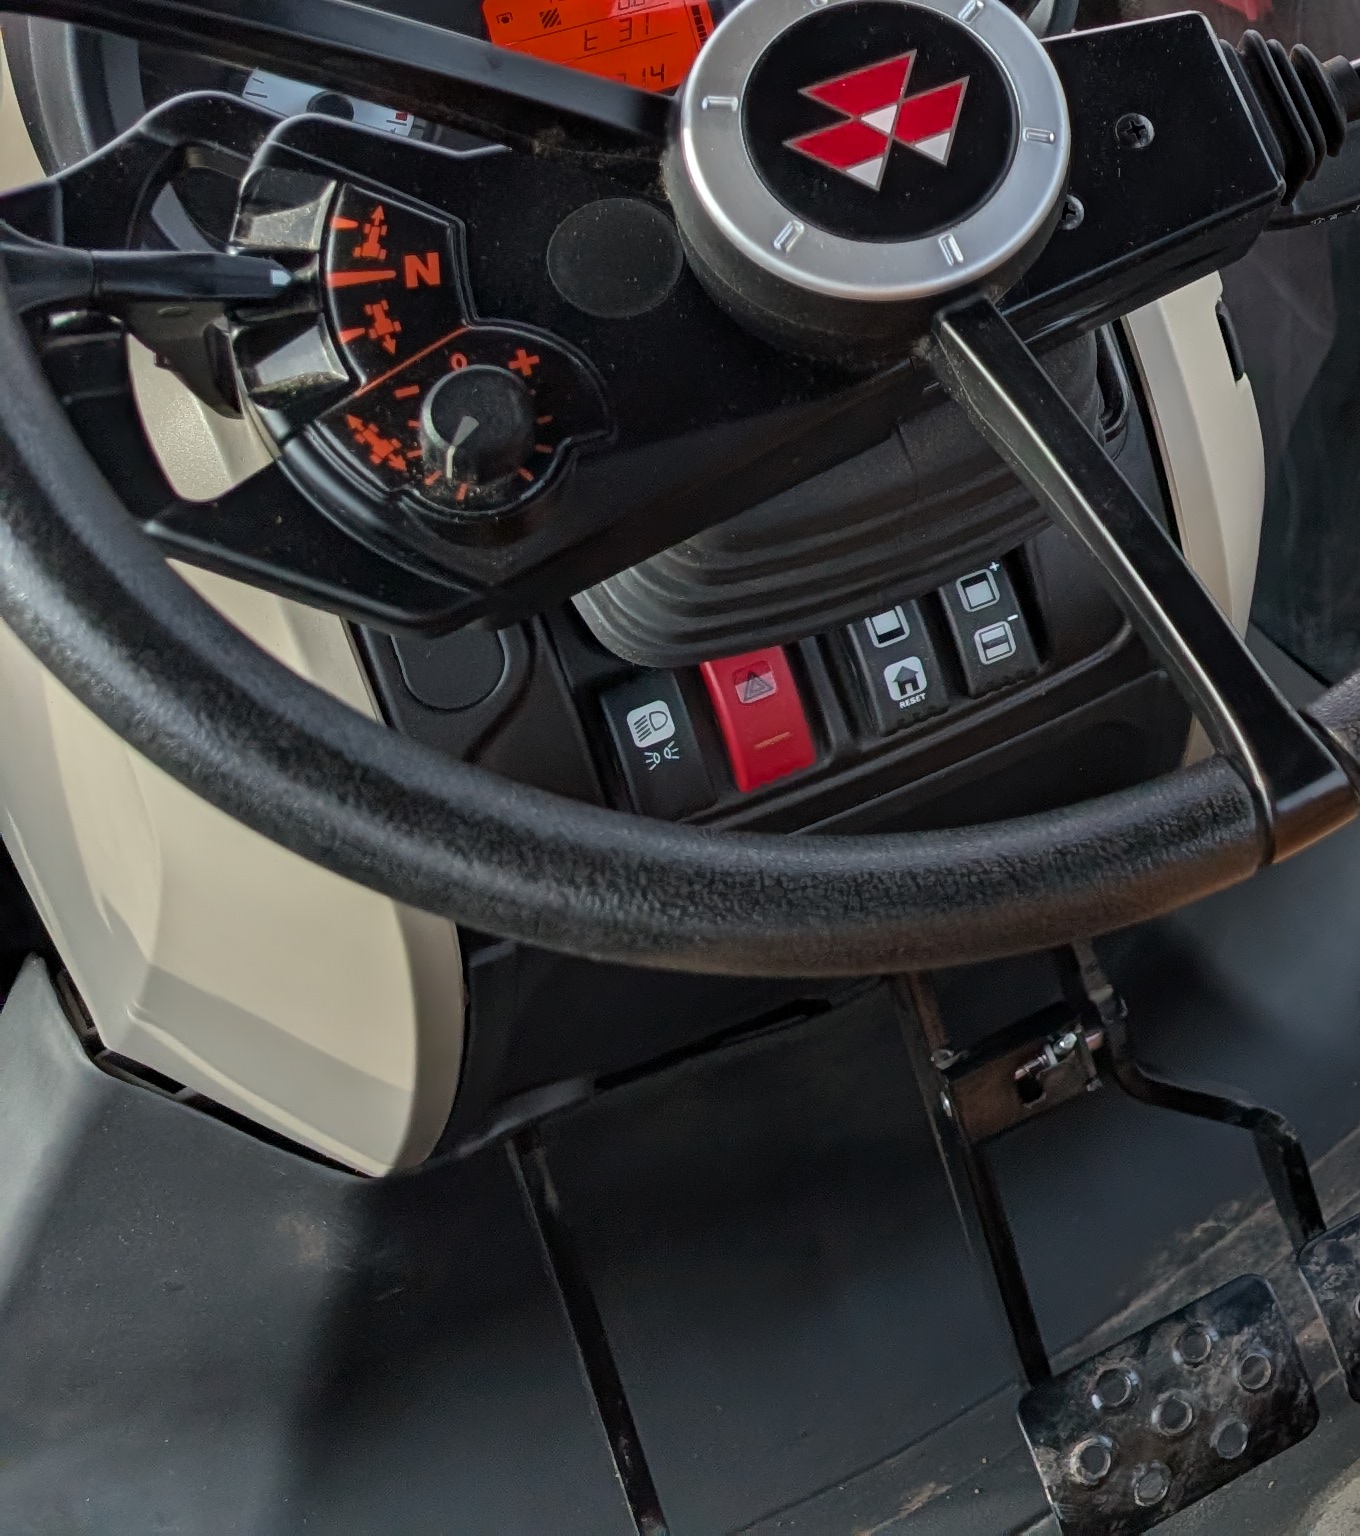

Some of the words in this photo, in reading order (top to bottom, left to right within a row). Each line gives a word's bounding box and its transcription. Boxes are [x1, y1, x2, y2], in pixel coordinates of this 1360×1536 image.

[618, 14, 650, 43] 31
[404, 251, 441, 288] N
[451, 352, 468, 371] 0
[899, 692, 926, 709] RESET
